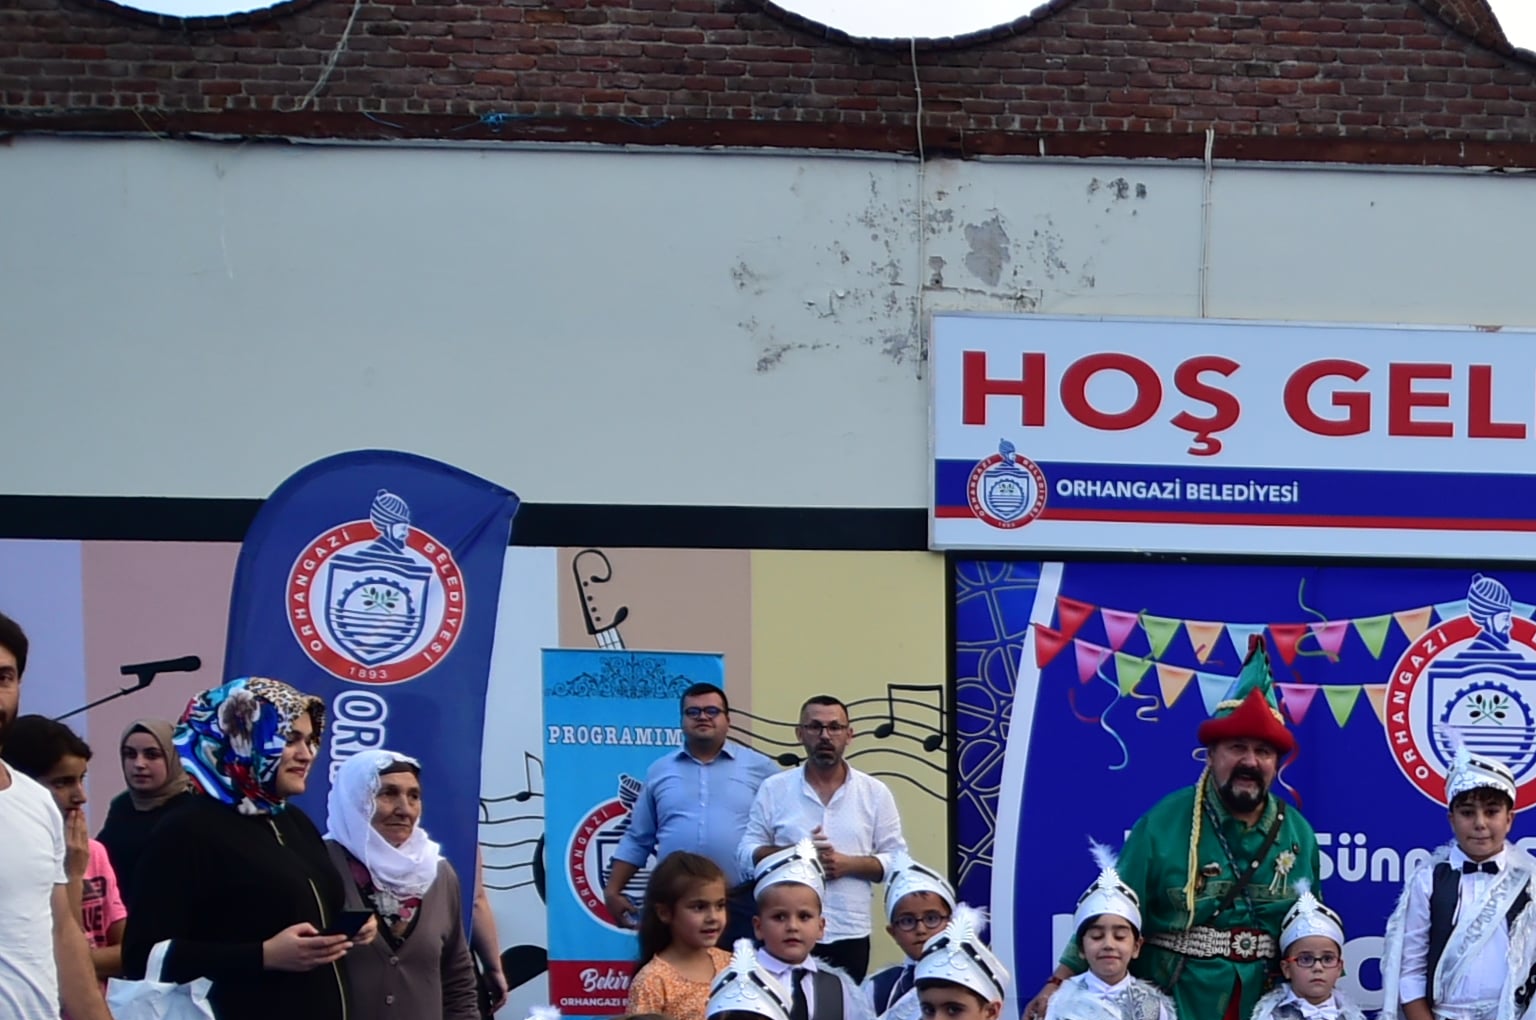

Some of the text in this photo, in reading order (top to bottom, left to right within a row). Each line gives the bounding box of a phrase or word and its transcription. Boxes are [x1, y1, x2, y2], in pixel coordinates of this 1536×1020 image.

[962, 350, 1241, 457] HOŞ
[1056, 478, 1299, 503] ORHANGAZİ BELEDİYESİ
[293, 527, 462, 664] ORHANGAZİ BELEDİYESİ
[349, 665, 388, 681] 1893
[1392, 628, 1449, 781] ORHANGAZİ
[547, 725, 685, 746] PROGRAMIM
[579, 967, 629, 993] Bekir
